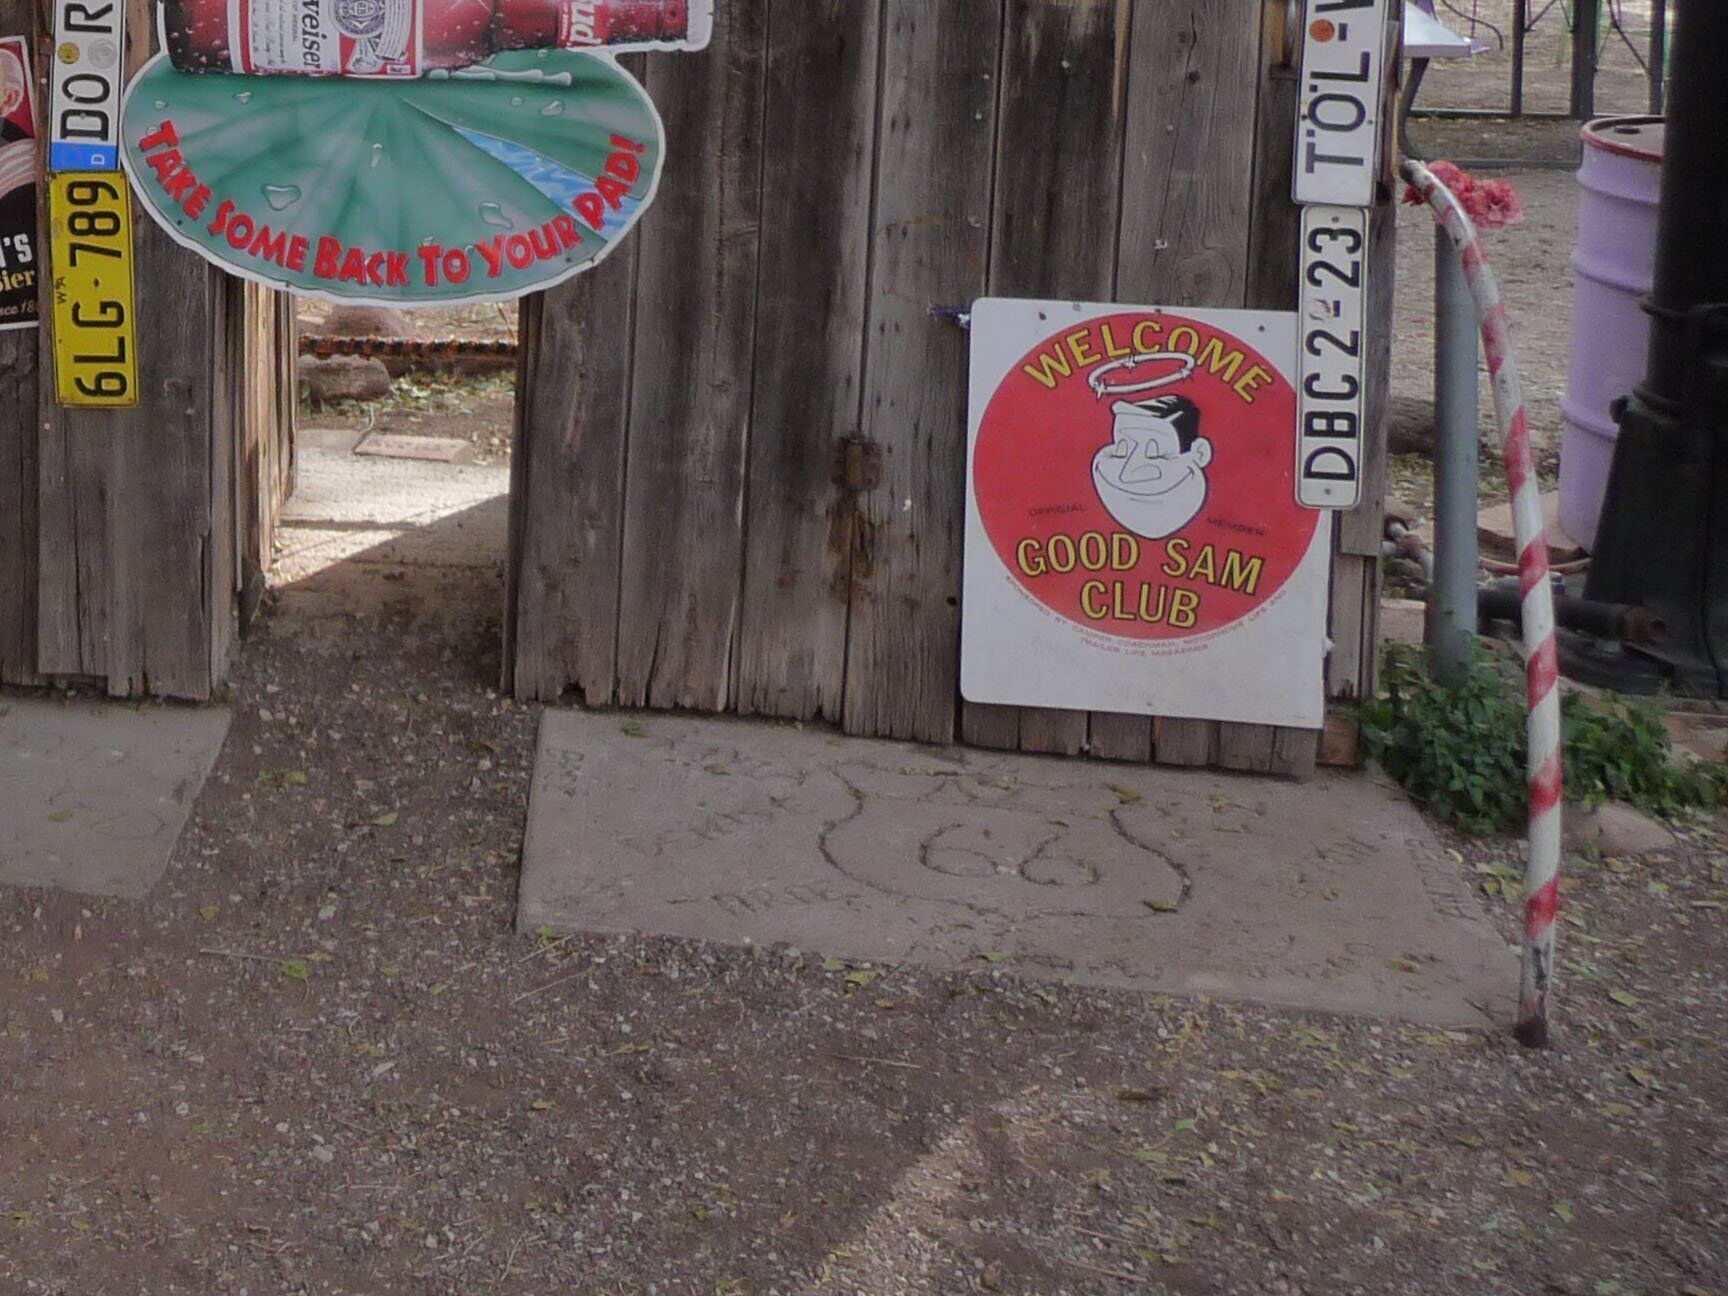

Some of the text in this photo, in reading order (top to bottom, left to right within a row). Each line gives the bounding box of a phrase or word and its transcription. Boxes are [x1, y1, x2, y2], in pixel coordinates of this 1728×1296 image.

[59, 73, 111, 142] DO
[139, 119, 647, 288] TAKE SOME BACK TO YOUR PAD!
[1023, 319, 1274, 405] WELCOME
[1016, 530, 1267, 597] GOOD SAM
[1078, 579, 1203, 630] CLUB
